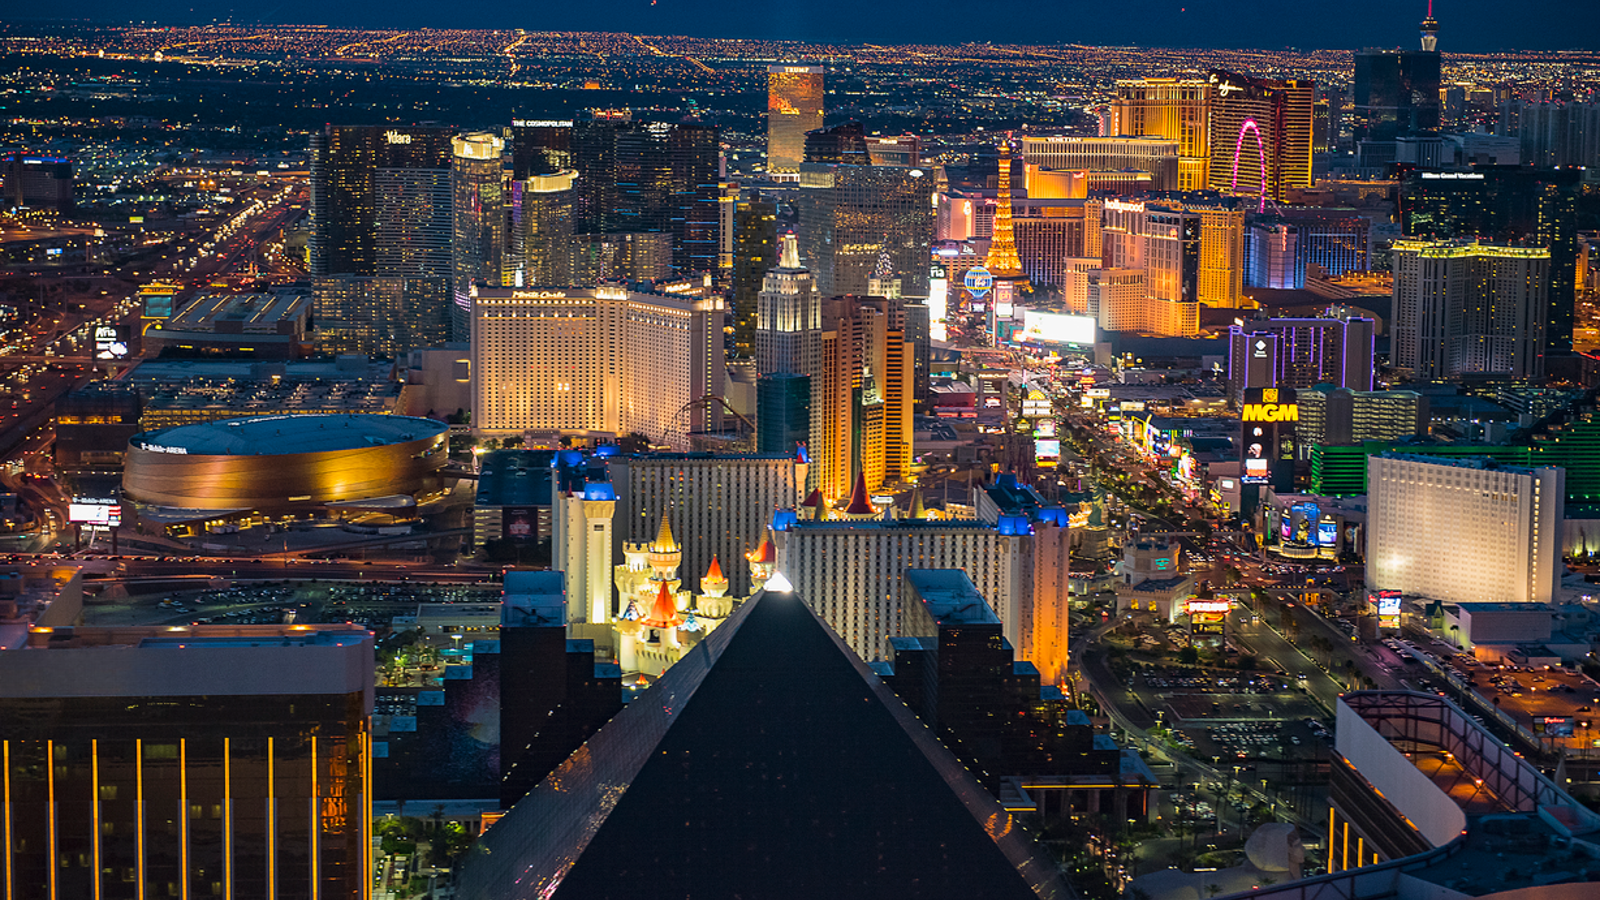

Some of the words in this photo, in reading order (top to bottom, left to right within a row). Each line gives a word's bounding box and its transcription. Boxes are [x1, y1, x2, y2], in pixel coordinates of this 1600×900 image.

[386, 130, 411, 144] Vdara
[1104, 197, 1145, 213] hollywood
[95, 327, 116, 337] Aria
[1241, 404, 1299, 422] MGM
